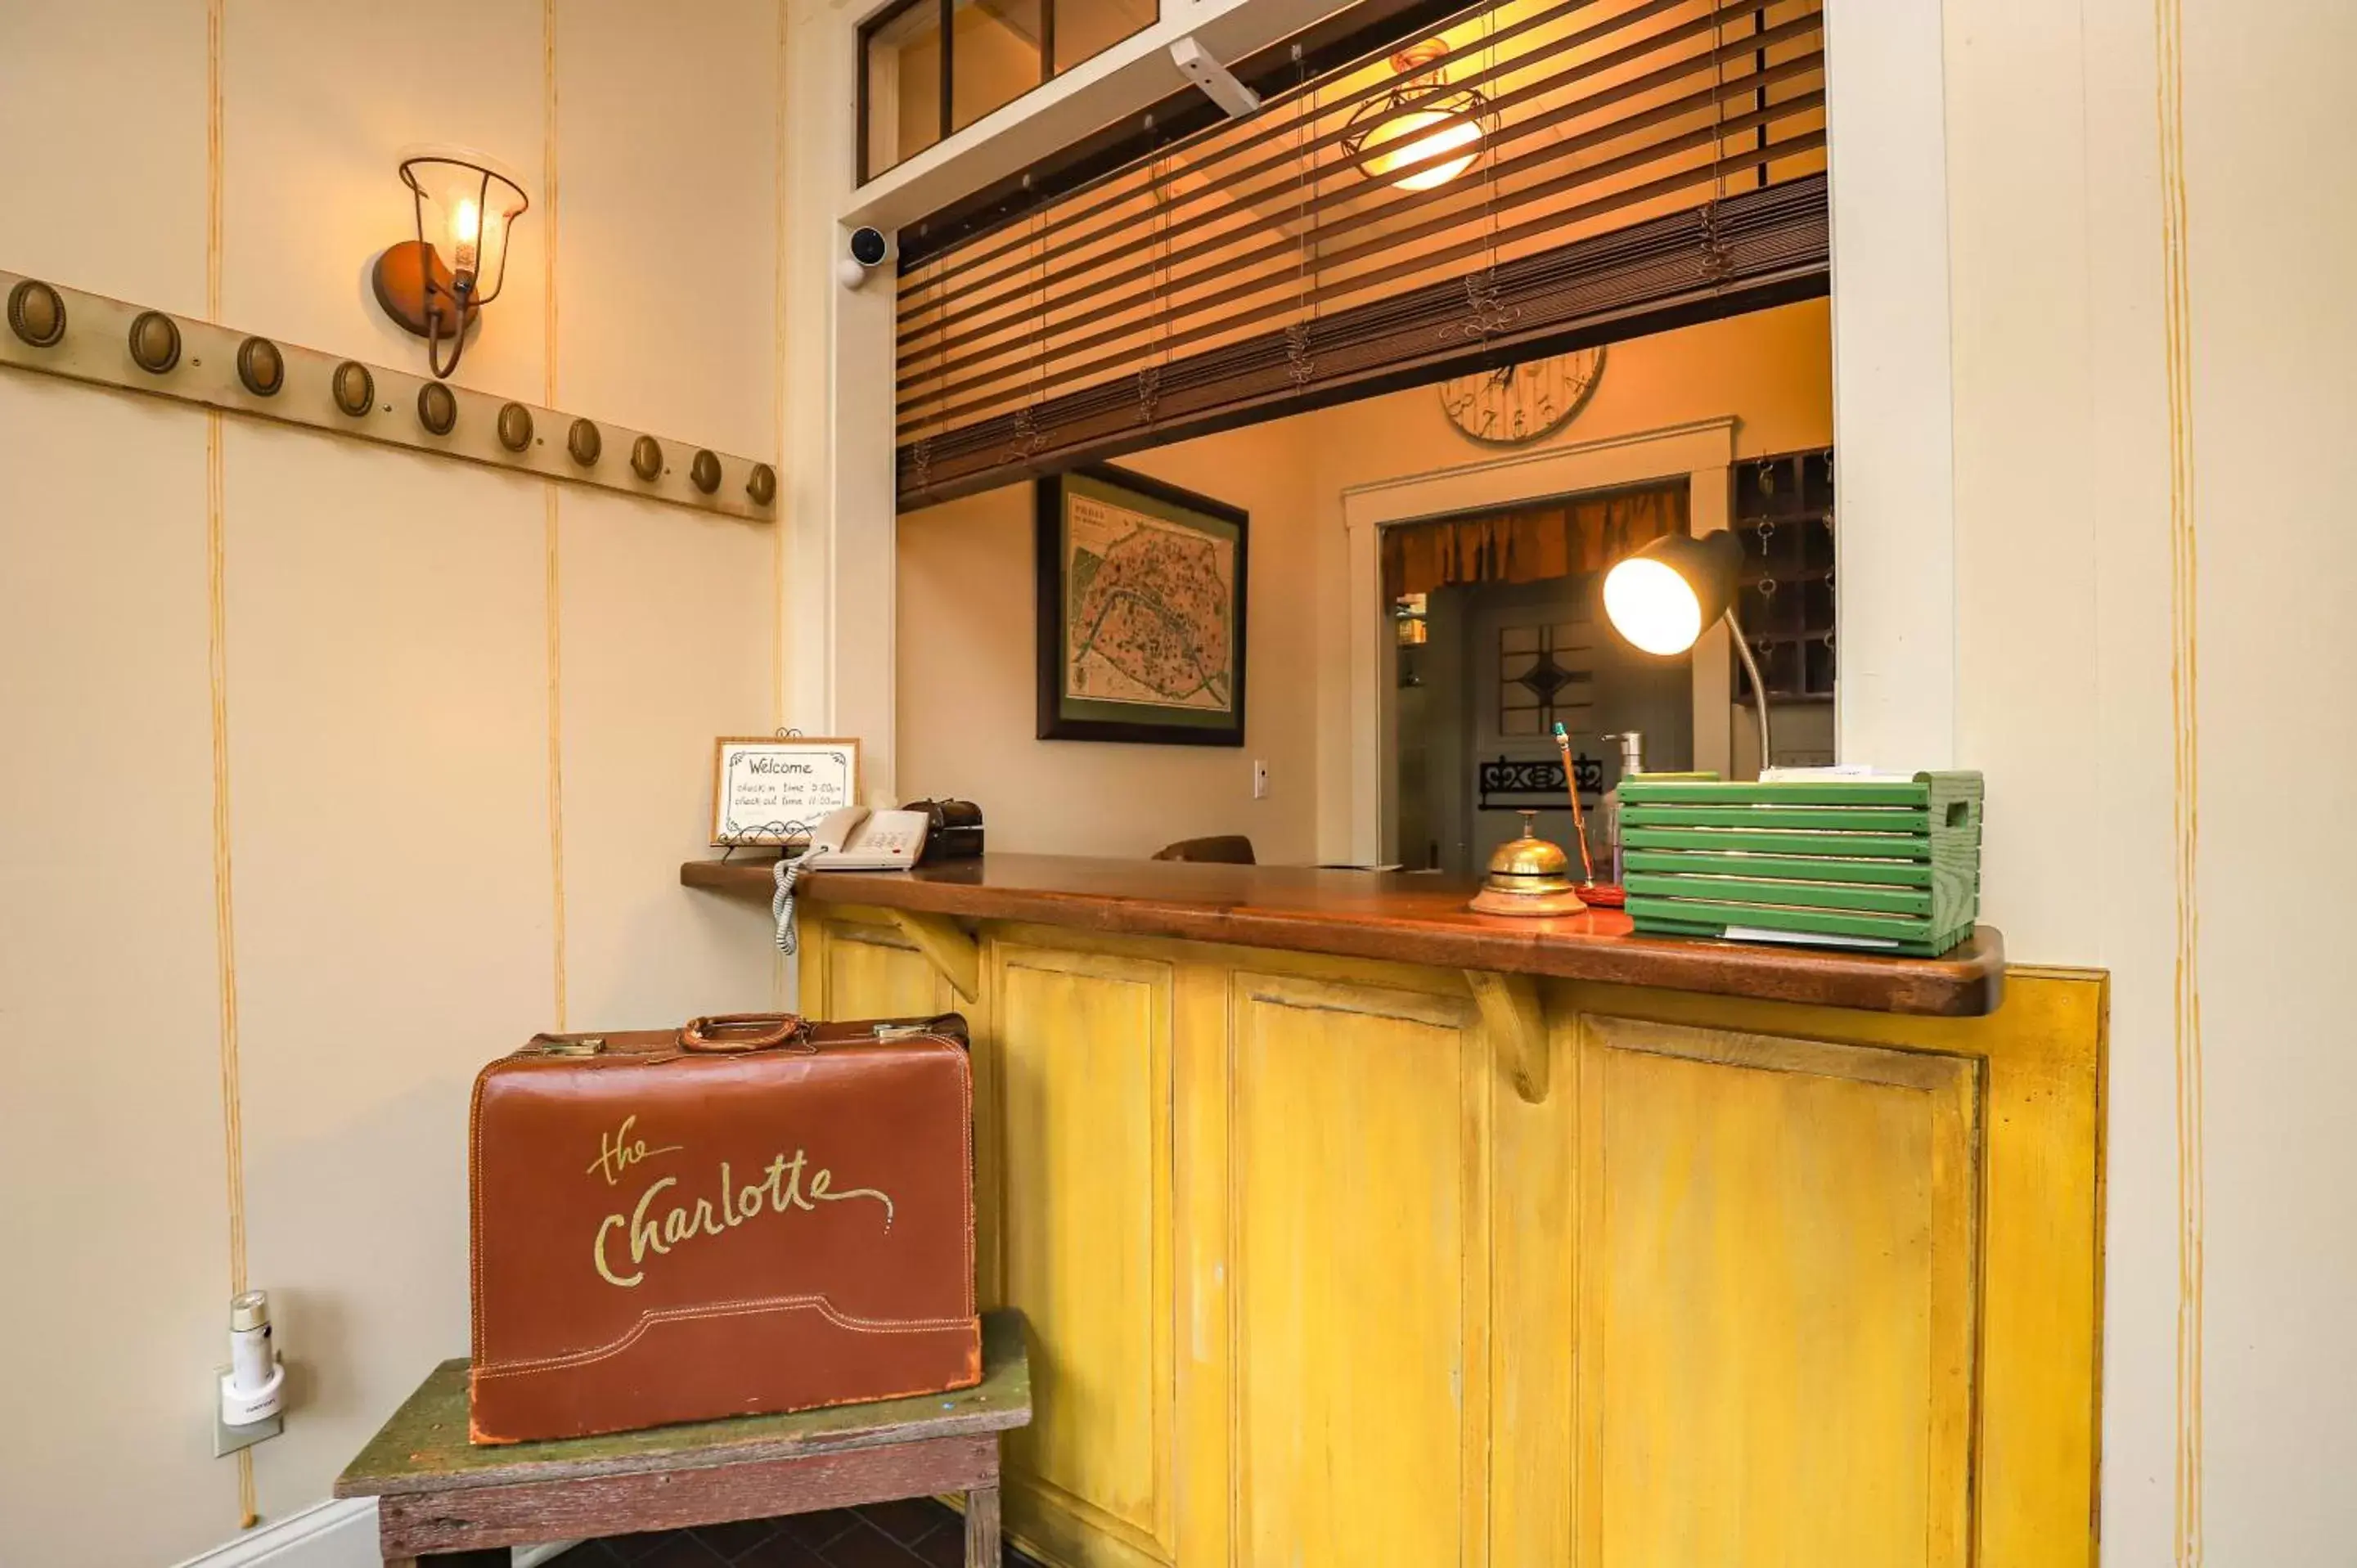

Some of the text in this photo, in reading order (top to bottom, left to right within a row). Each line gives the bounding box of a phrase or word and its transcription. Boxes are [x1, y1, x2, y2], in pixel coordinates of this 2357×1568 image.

[749, 757, 813, 774] Welcome
[783, 782, 804, 793] time
[782, 796, 803, 806] time
[586, 1114, 684, 1186] the
[594, 1149, 894, 1287] Charlotte
